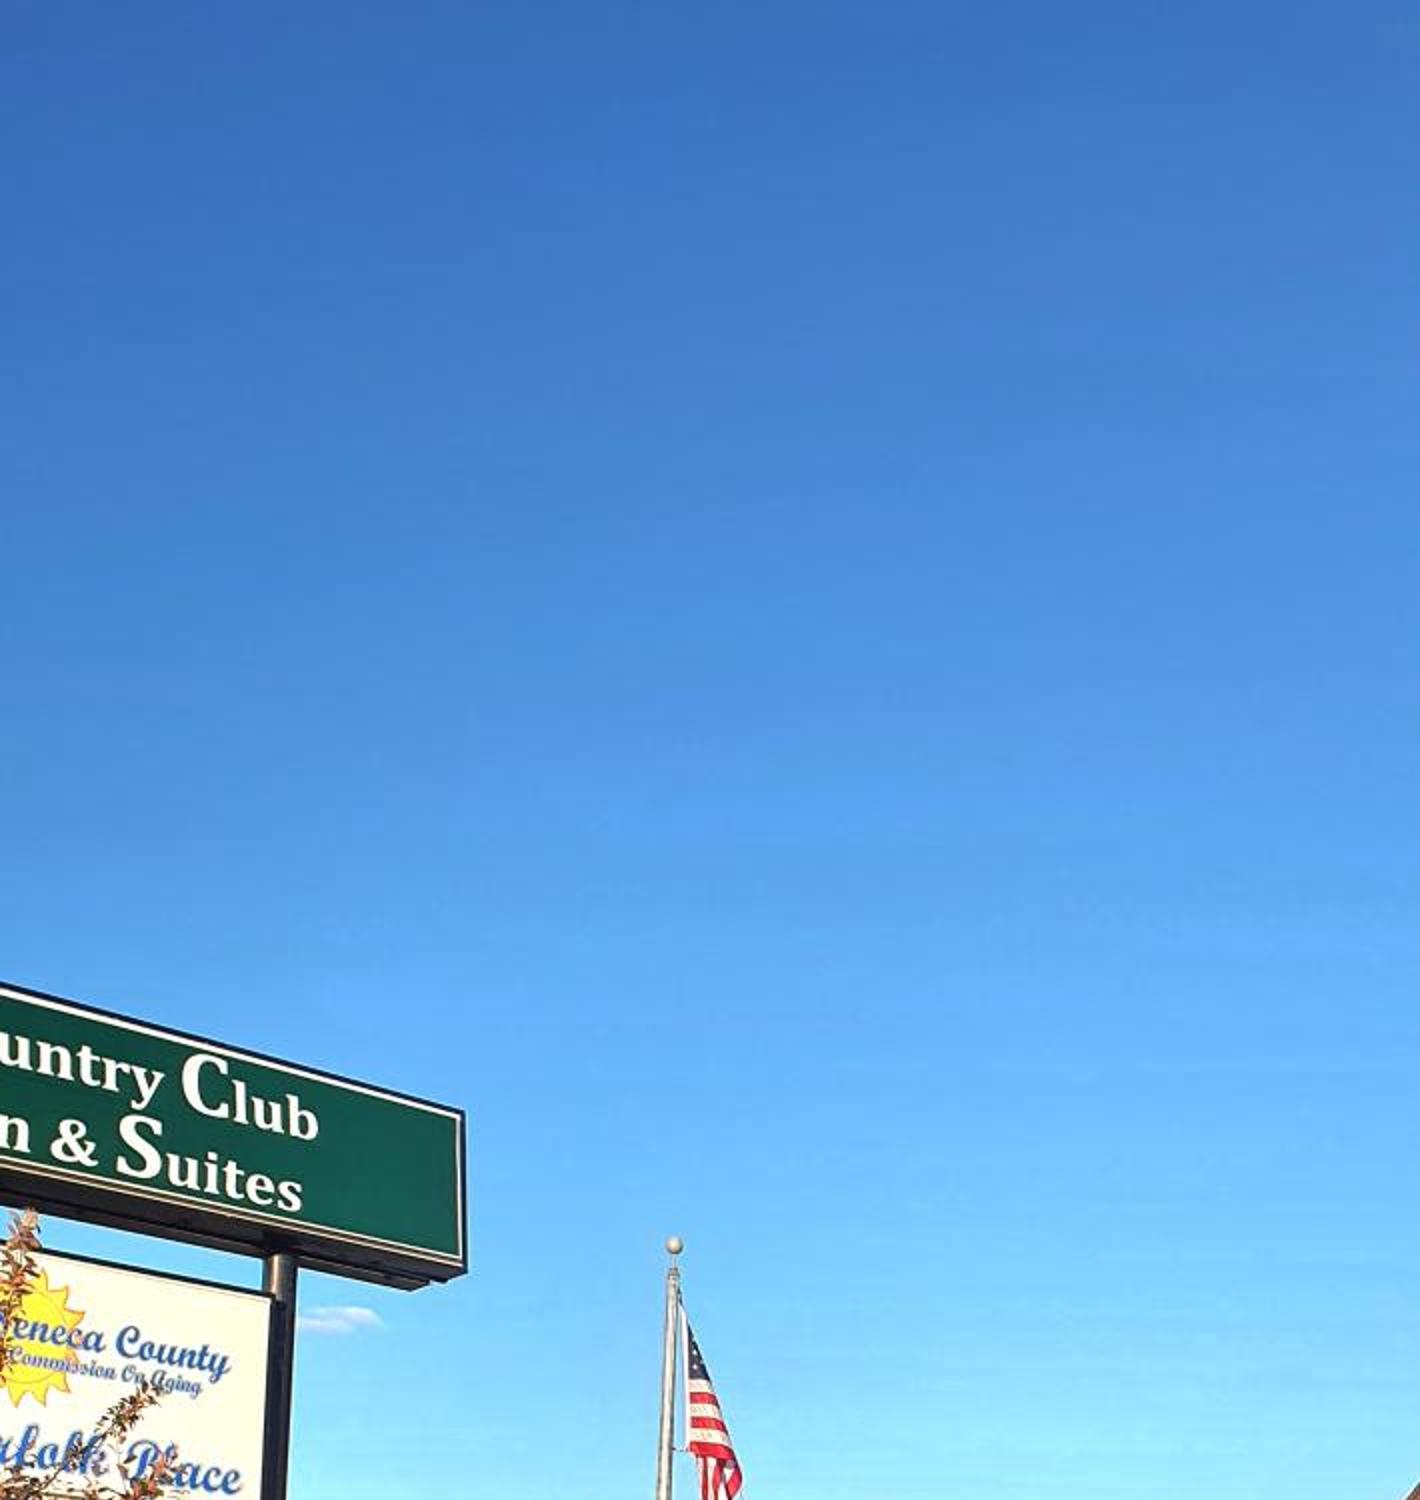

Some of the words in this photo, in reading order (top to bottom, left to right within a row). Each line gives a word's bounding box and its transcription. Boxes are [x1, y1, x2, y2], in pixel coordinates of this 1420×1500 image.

[182, 1053, 319, 1141] Club
[50, 1118, 99, 1167] &
[116, 1114, 303, 1213] Suites
[0, 1311, 105, 1352] eneca
[115, 1325, 231, 1384] County
[121, 1364, 146, 1386] On
[150, 1369, 202, 1400] Aging
